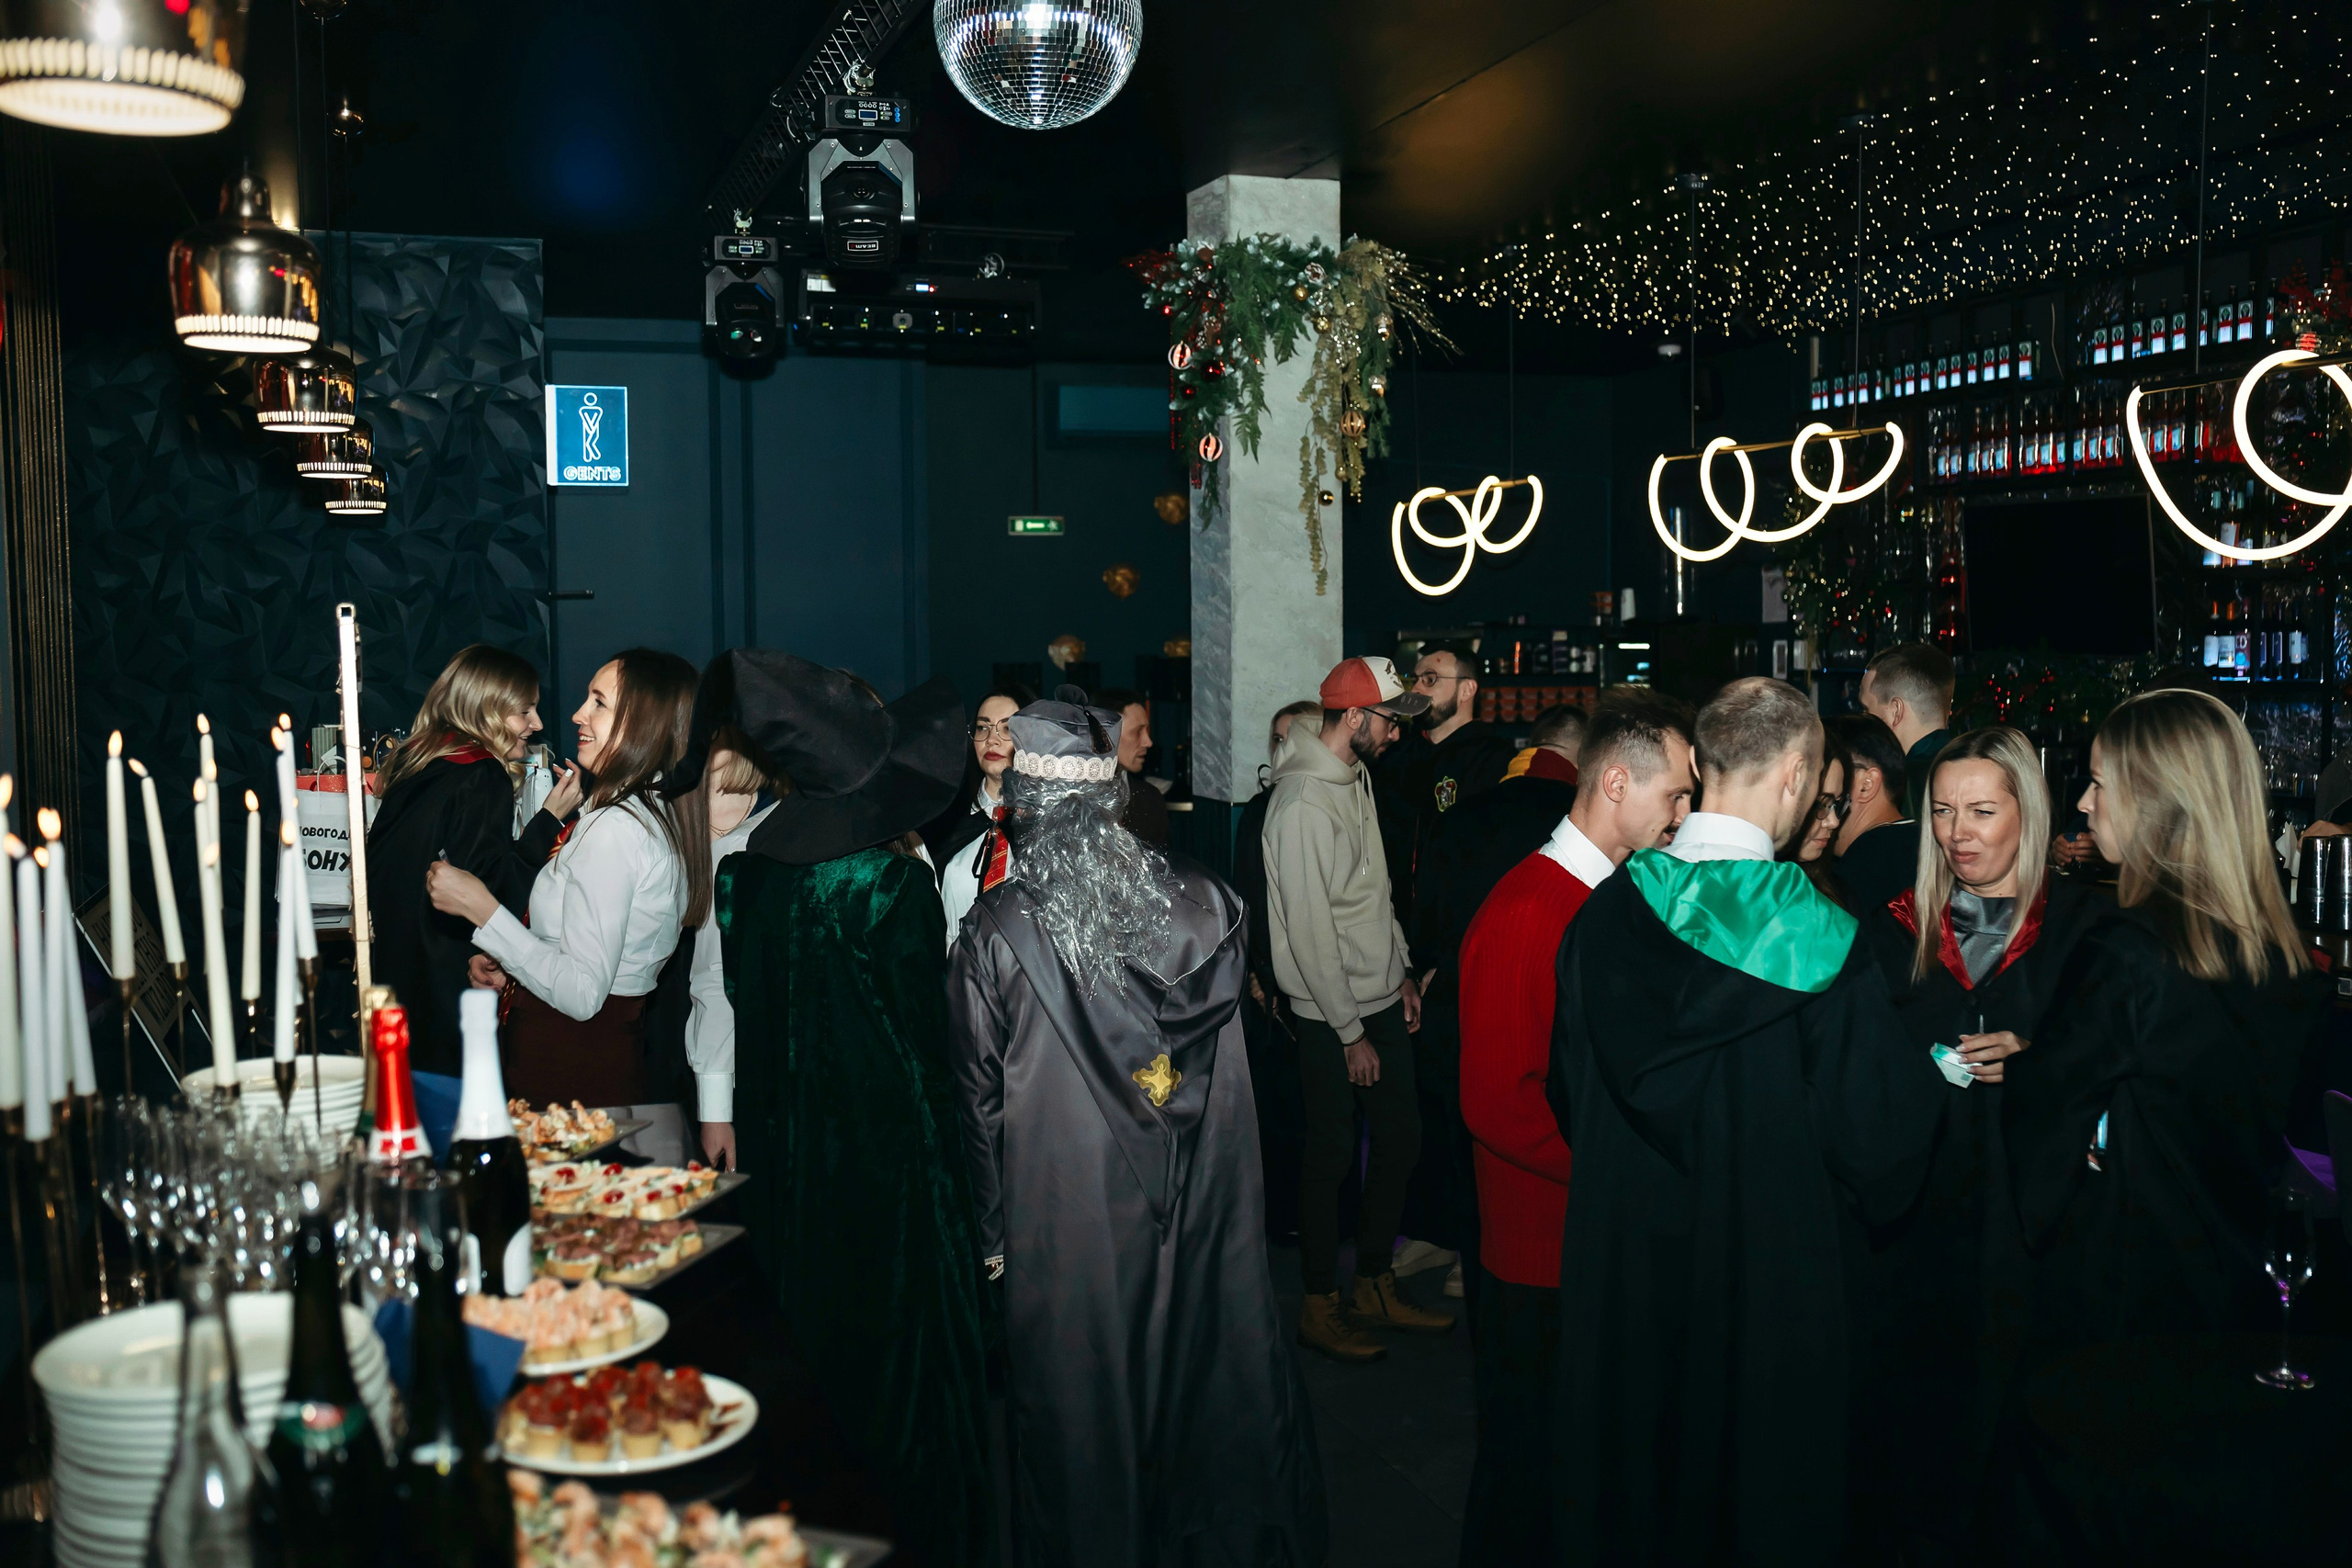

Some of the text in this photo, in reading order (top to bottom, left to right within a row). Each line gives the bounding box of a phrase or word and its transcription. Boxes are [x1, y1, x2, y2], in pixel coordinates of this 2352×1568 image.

[563, 465, 622, 481] GENTS
[300, 826, 350, 840] ОВОГОД
[134, 931, 164, 974] THIS
